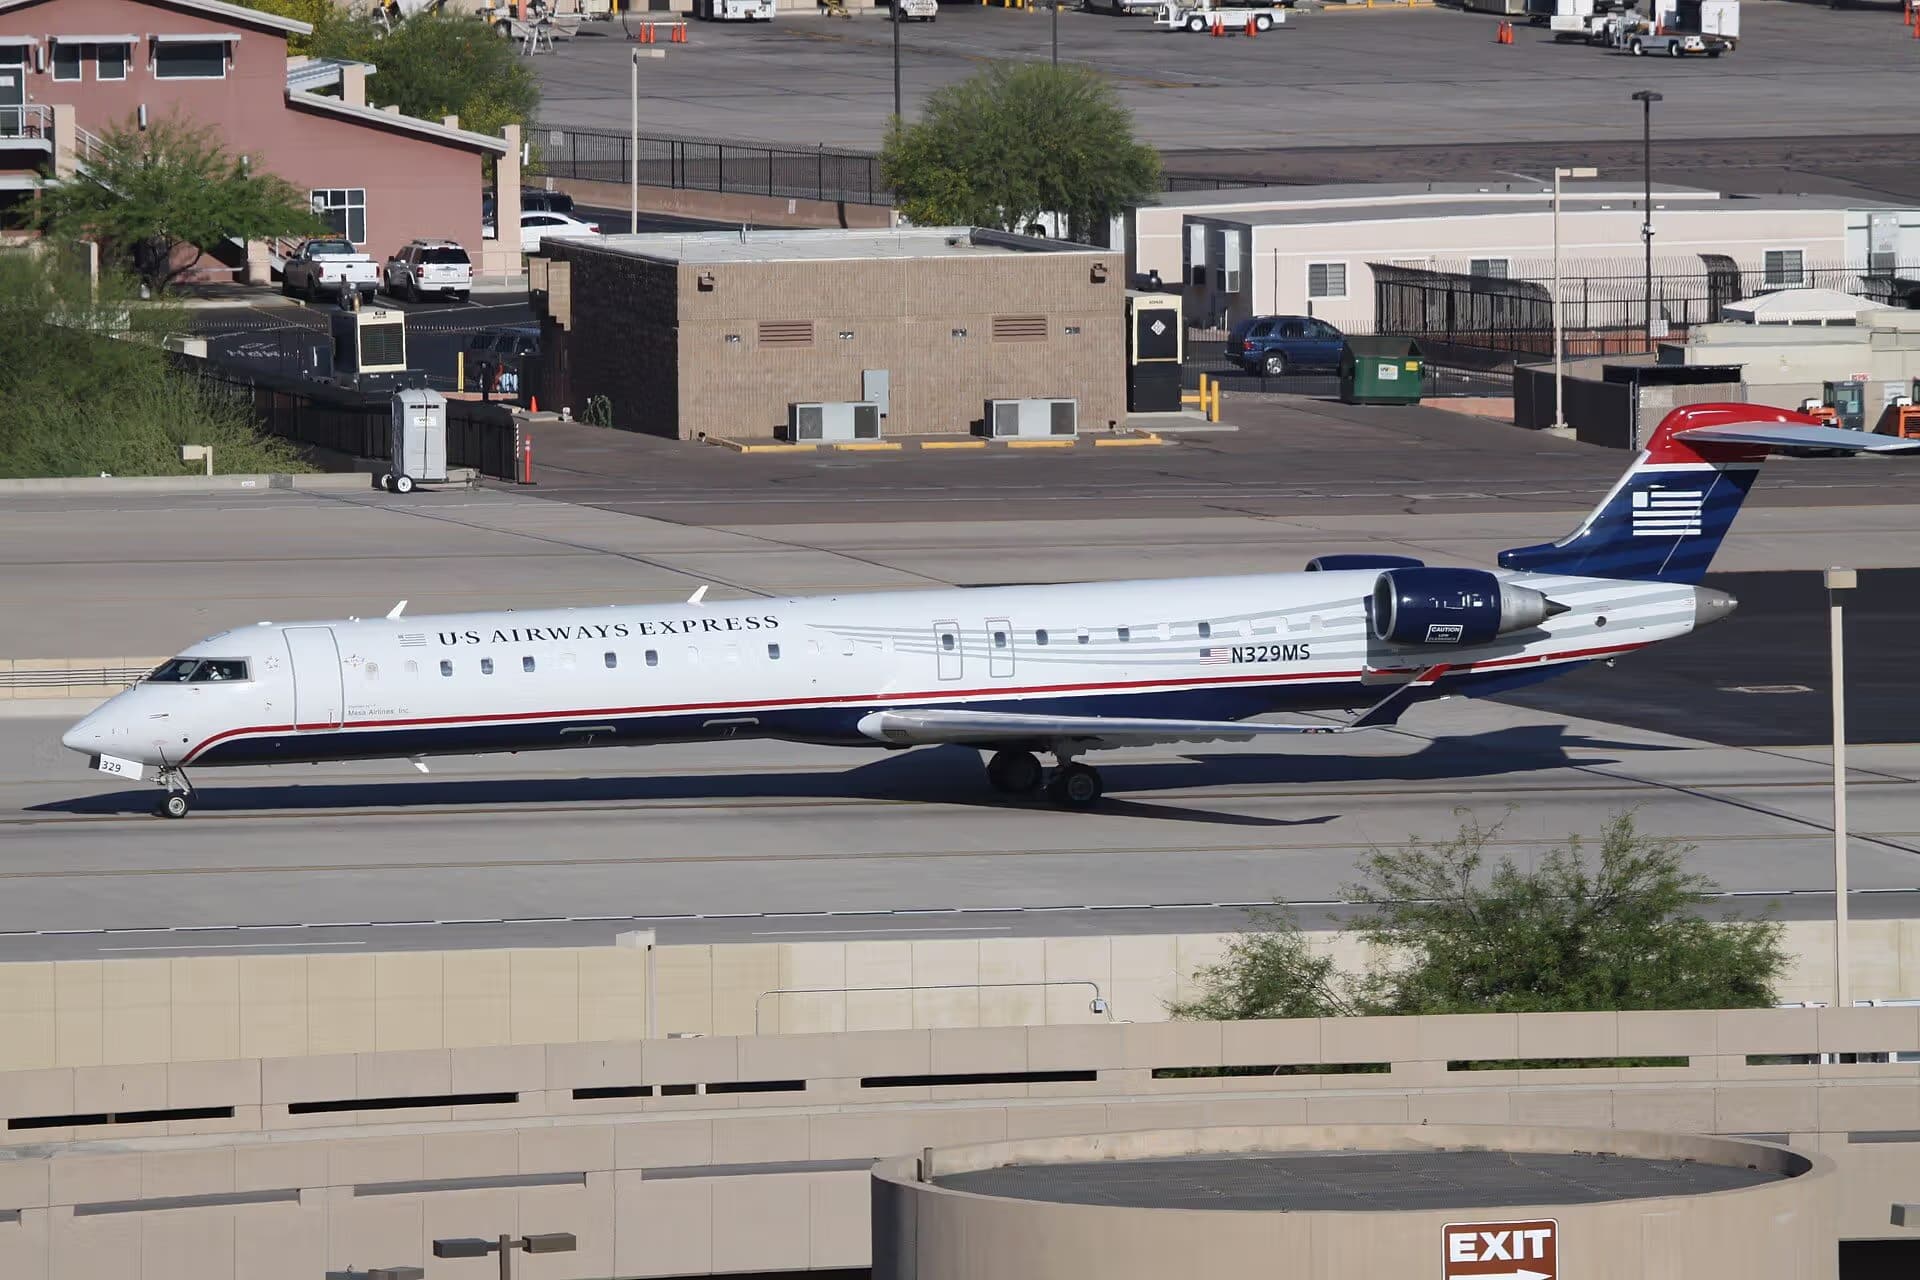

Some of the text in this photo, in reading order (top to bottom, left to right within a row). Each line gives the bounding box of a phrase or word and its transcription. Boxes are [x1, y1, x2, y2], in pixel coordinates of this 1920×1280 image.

[491, 623, 629, 643] AIRWAYS
[638, 615, 779, 636] EXPRESS
[1231, 643, 1311, 664] N329MS
[101, 760, 122, 773] 329
[1449, 1229, 1552, 1262] EXIT
